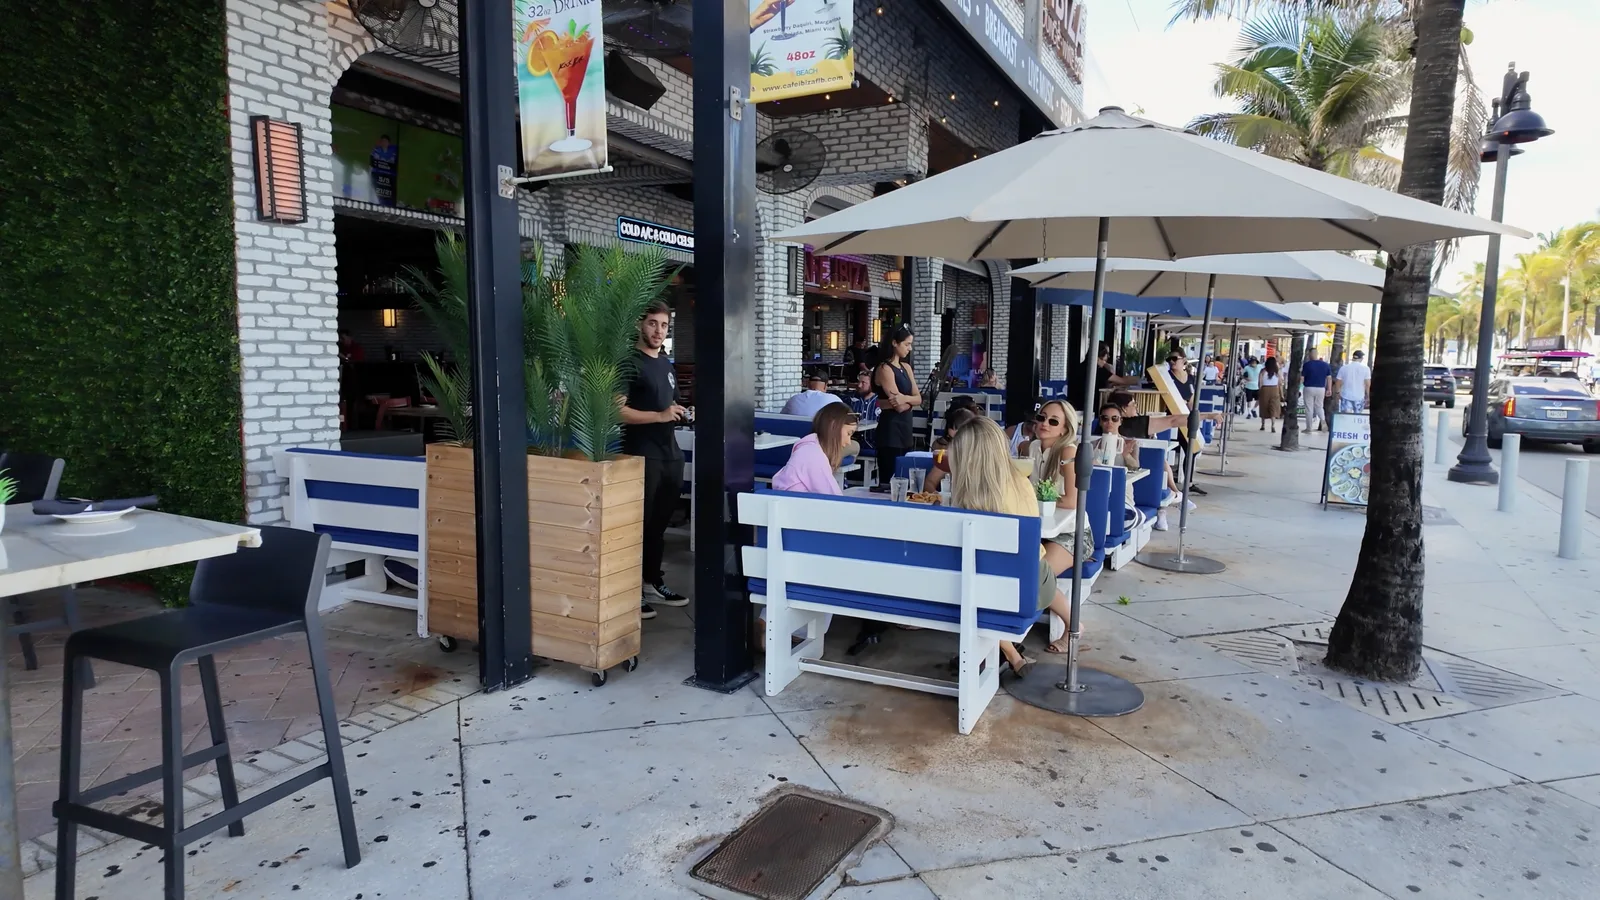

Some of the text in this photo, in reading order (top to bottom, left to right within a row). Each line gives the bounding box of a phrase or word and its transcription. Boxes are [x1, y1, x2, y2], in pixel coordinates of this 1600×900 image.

[553, 0, 596, 14] DRIN
[763, 25, 791, 35] Strawbry
[984, 3, 1018, 68] BREAKFAST
[1028, 56, 1040, 95] LIVE
[786, 50, 816, 62] 48oz
[796, 68, 818, 76] BEACH
[762, 75, 844, 92] www.cafeibizaflb.com
[620, 221, 641, 238] COLD
[640, 226, 654, 240] A/C
[653, 229, 660, 241] &
[659, 230, 677, 245] COLD
[1332, 431, 1358, 440] FRESH
